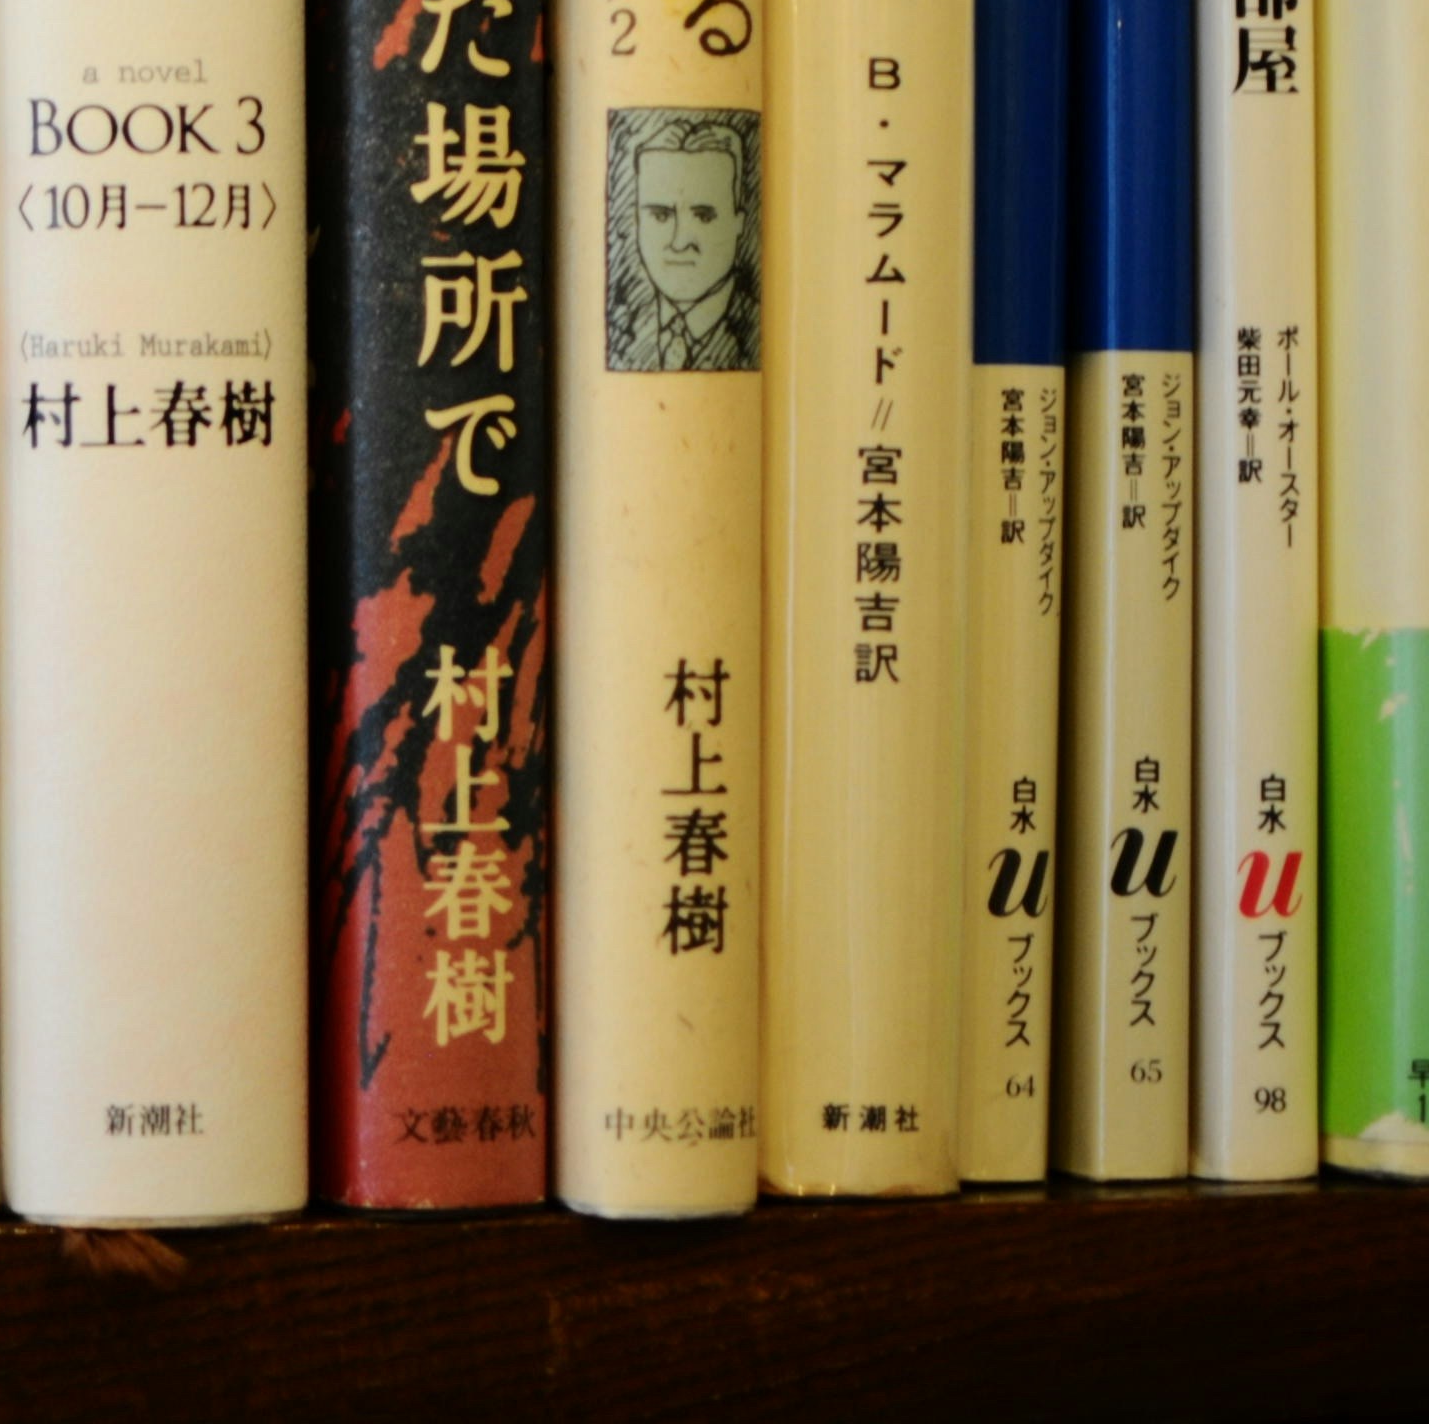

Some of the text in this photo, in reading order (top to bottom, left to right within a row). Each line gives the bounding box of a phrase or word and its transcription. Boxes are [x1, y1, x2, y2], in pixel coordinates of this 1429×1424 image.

[82, 60, 207, 84] a novel
[28, 96, 266, 157] BOOK 3
[22, 379, 276, 450] 村上春樹
[661, 657, 730, 956] 村上春樹
[420, 643, 514, 1049] 村上春樹
[1005, 1075, 1036, 1098] 64
[1130, 1059, 1163, 1084] 65
[821, 1102, 921, 1132] 新潮社
[1254, 1088, 1287, 1113] 98
[105, 1102, 204, 1138] 新潮社
